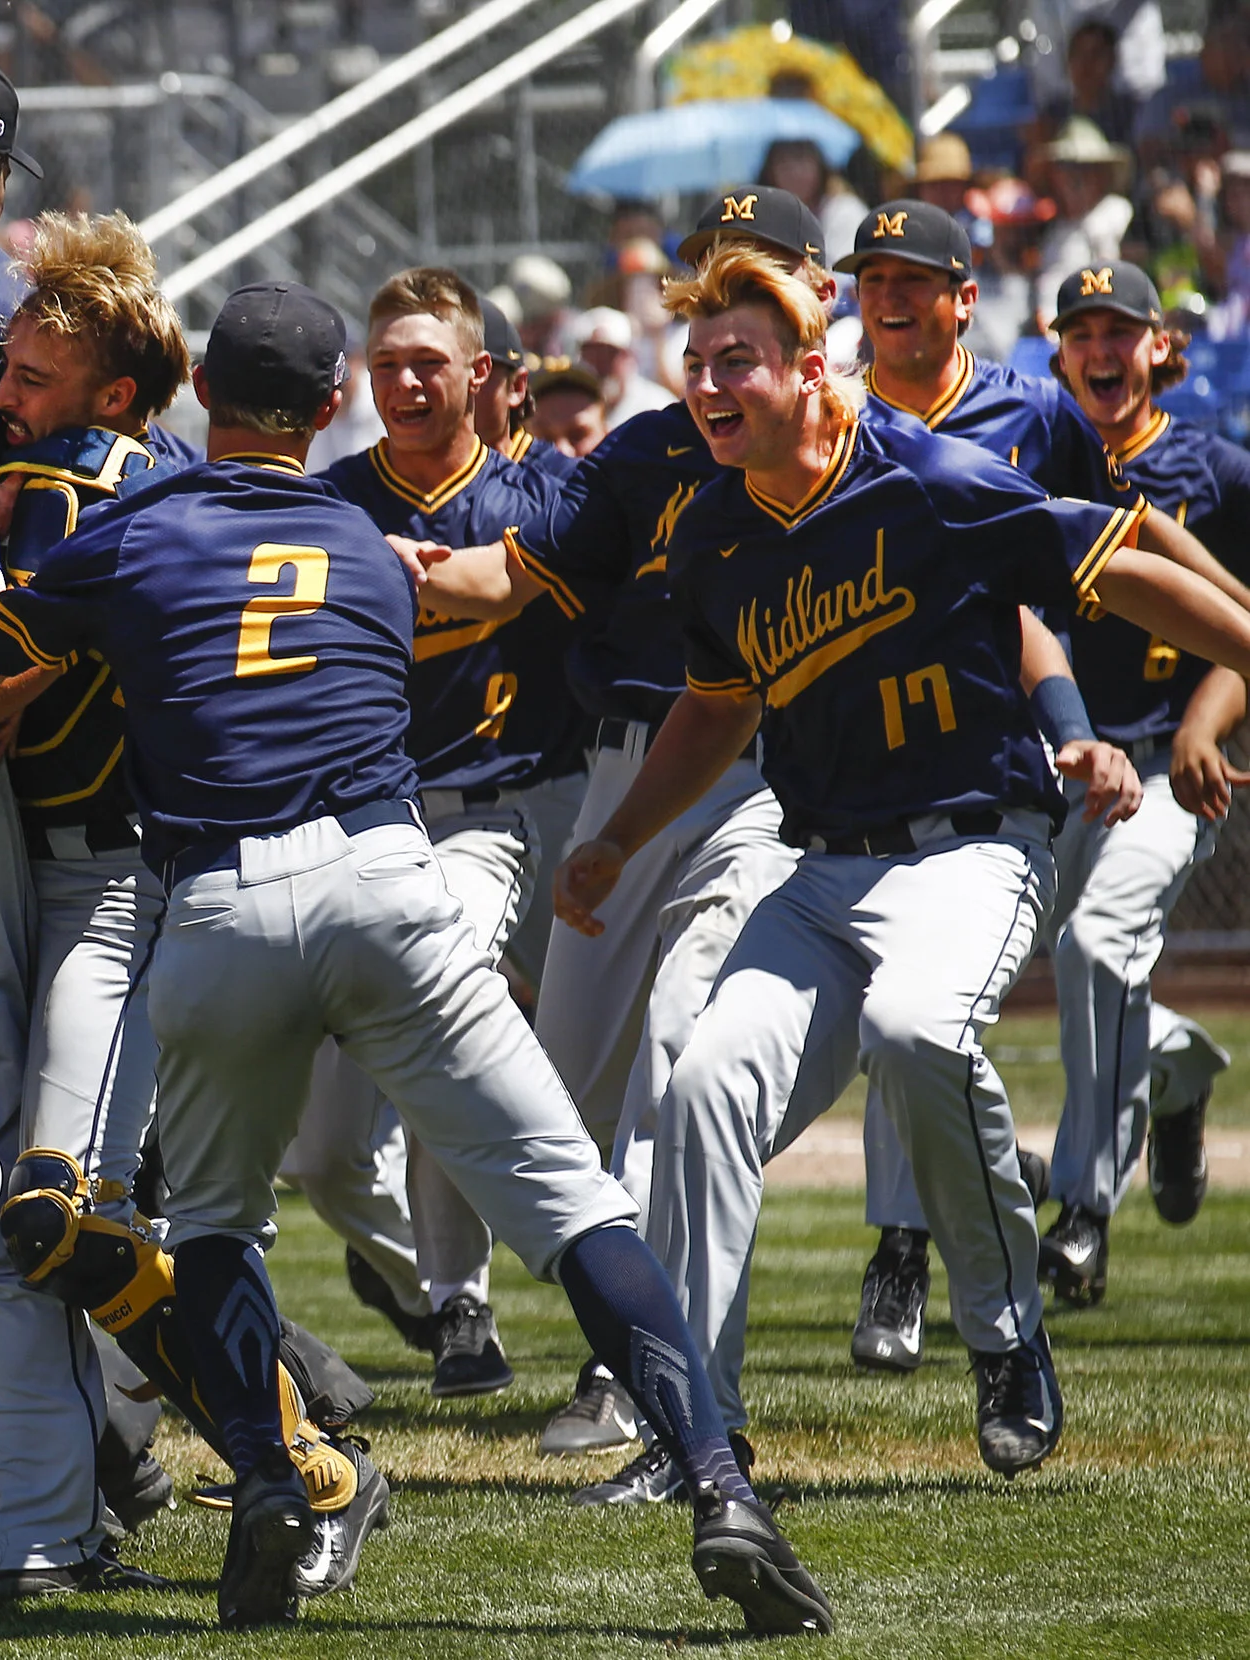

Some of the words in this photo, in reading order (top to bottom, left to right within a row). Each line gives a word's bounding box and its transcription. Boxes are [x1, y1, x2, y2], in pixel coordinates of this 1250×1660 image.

[721, 194, 759, 222] M
[873, 211, 909, 239] M
[1079, 266, 1114, 297] M
[234, 541, 330, 678] 2
[737, 527, 898, 685] Midland
[879, 662, 957, 752] 17
